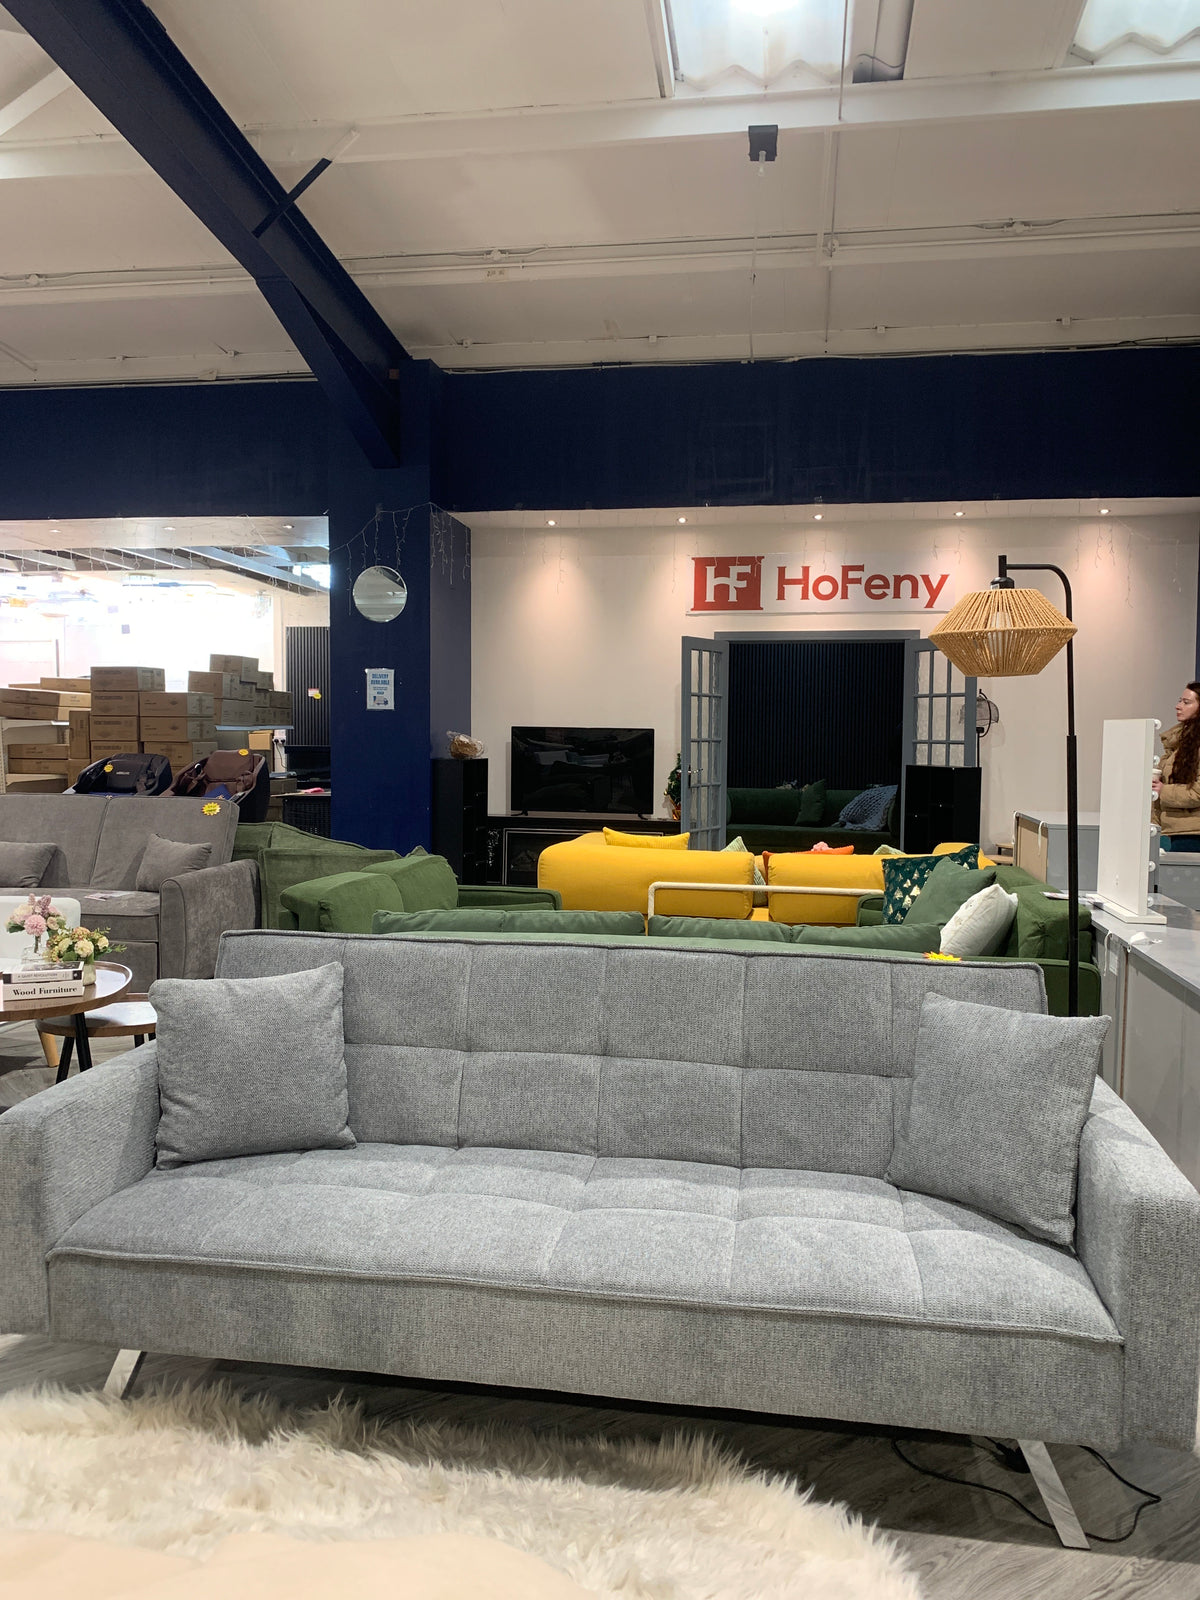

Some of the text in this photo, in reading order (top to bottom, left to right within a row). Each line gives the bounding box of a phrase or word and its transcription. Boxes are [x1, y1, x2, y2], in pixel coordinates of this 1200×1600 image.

[775, 563, 951, 608] HoFeny
[13, 986, 77, 996] Wood Furniture
